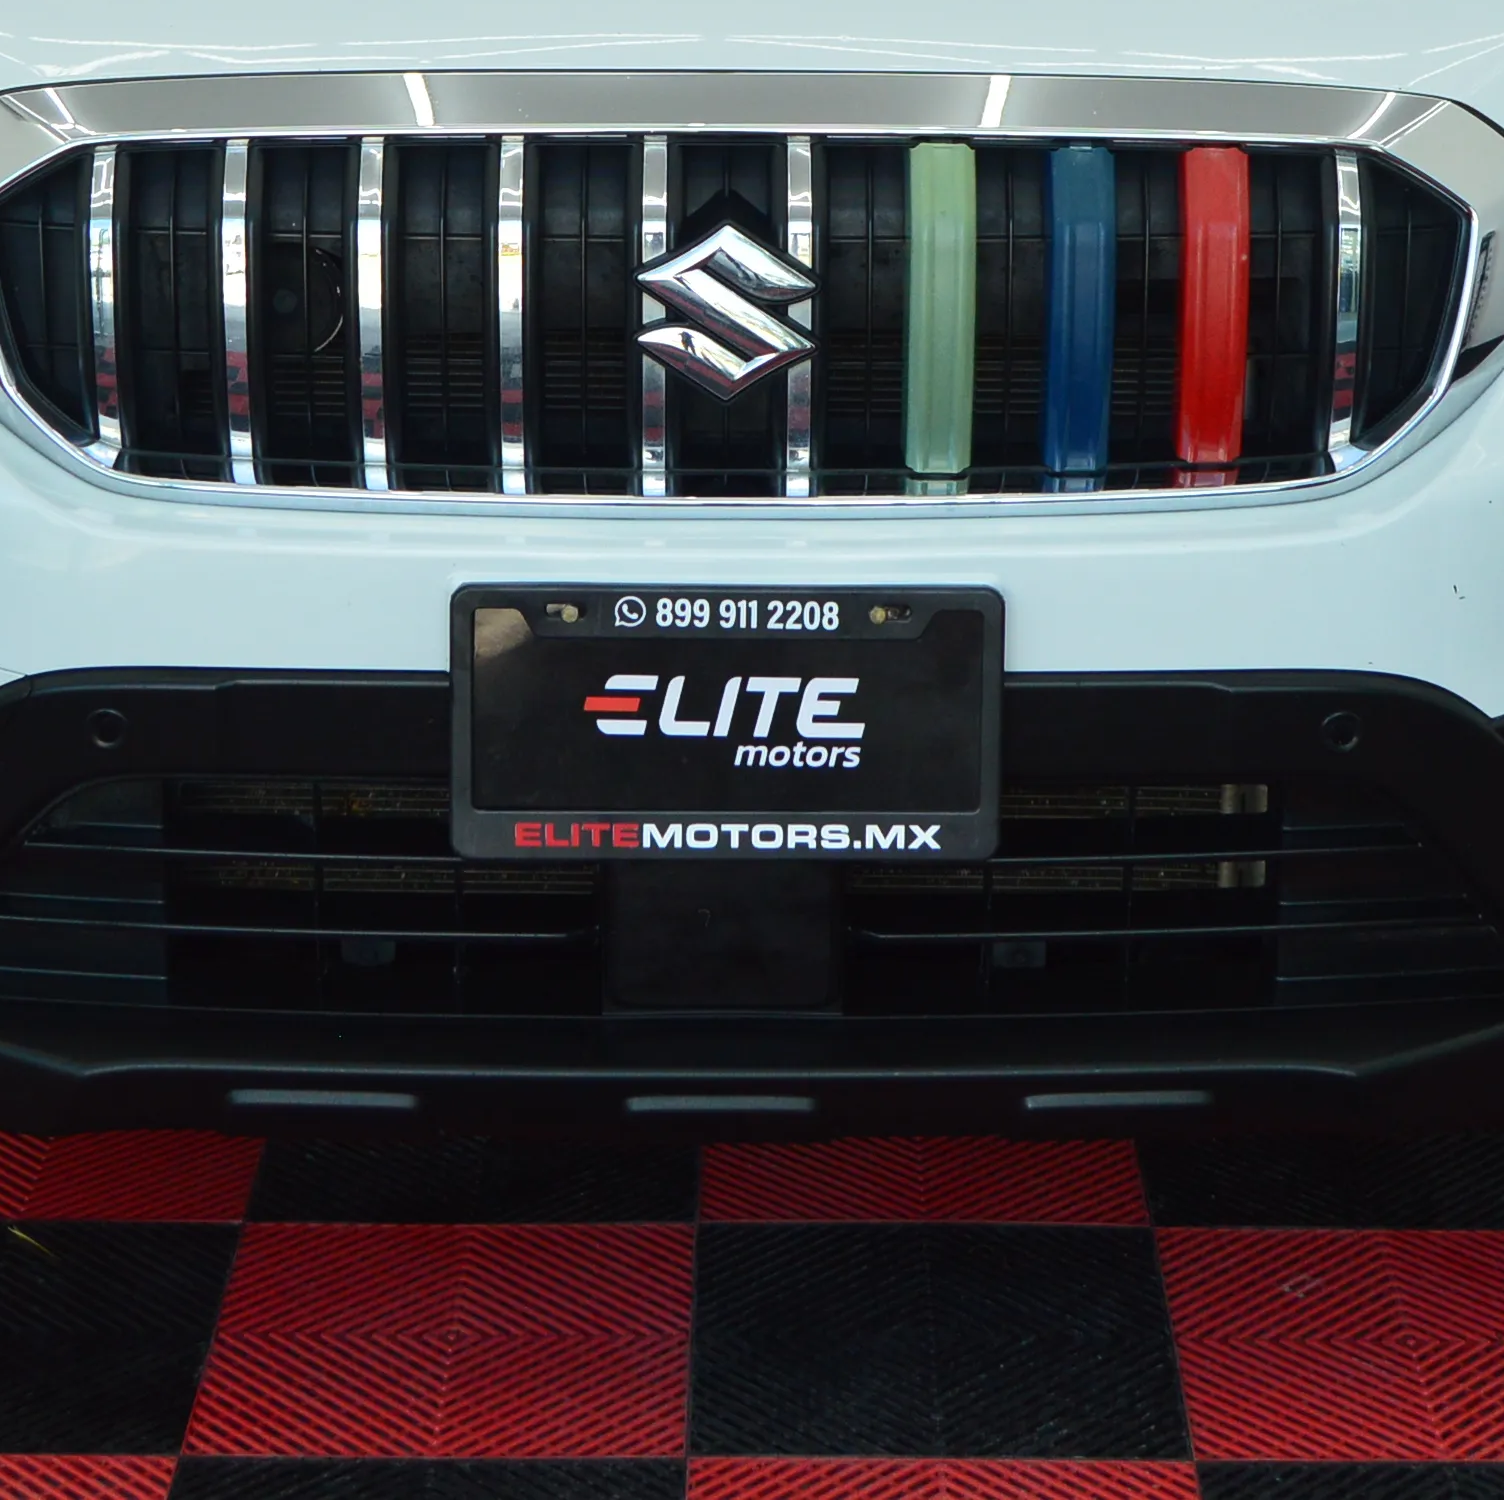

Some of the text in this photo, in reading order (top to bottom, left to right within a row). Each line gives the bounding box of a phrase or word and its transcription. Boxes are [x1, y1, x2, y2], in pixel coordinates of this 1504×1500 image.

[655, 599, 841, 631] 899 911 2208
[583, 674, 867, 740] ELITE
[734, 741, 862, 769] motors
[514, 822, 943, 851] ELITEMOTORS.MX
